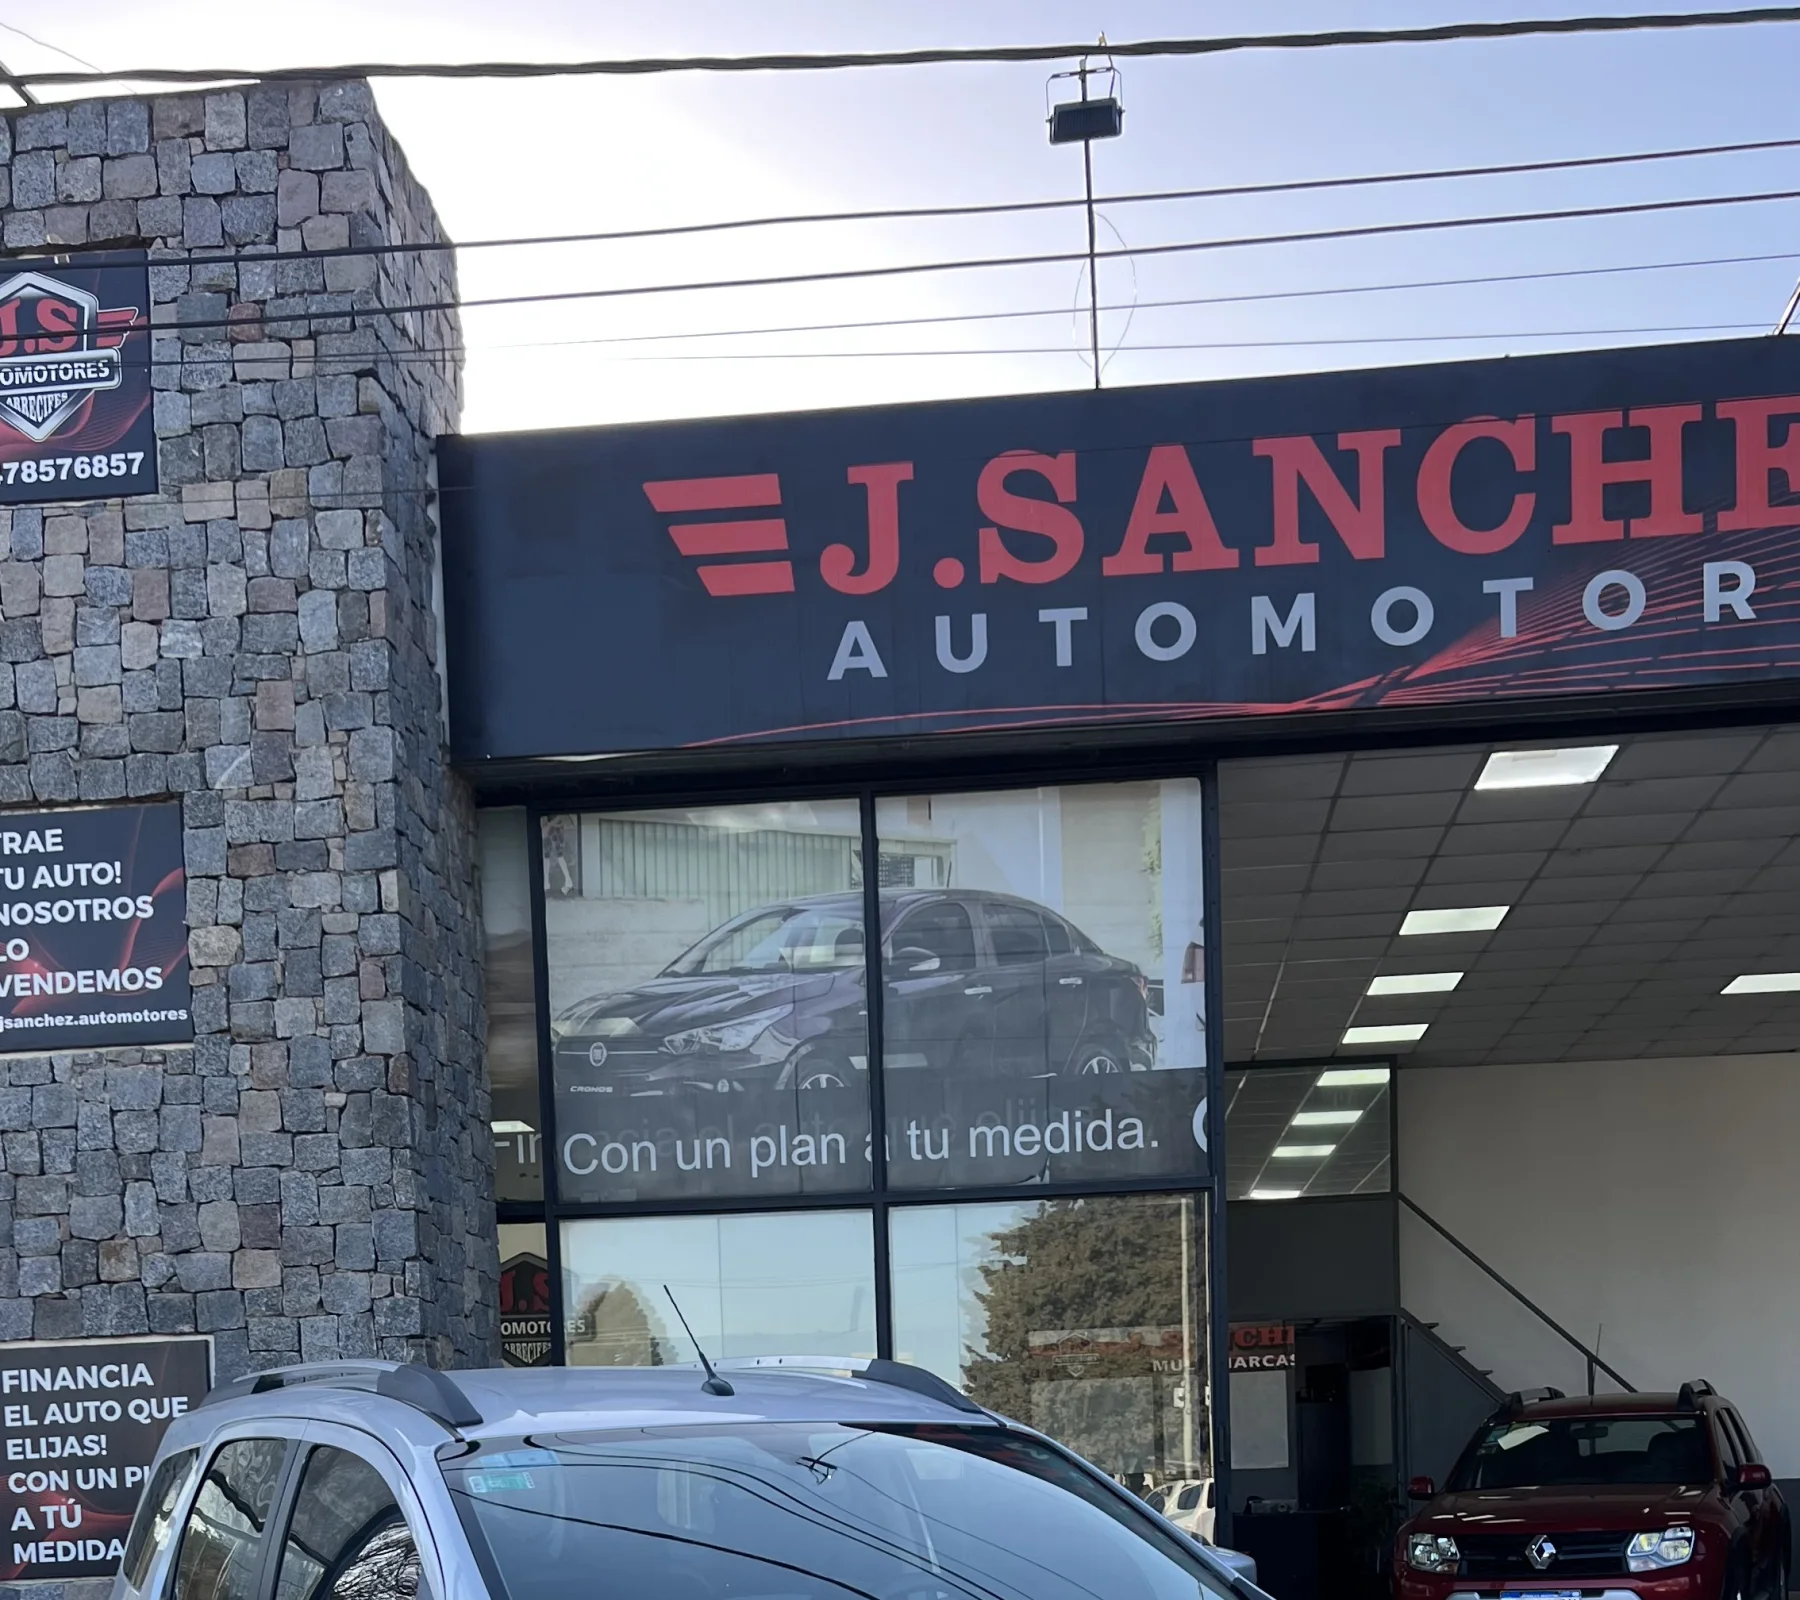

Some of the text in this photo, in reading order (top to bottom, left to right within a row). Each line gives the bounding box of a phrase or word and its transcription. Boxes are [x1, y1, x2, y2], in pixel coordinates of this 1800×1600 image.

[6, 392, 68, 422] ARRECIFES
[0, 452, 144, 484] 78576857
[820, 395, 1800, 594] J.SANCHE
[827, 560, 1757, 681] AUTOMOTOR
[0, 829, 64, 854] RAE
[32, 861, 122, 889] AUTO!
[563, 1133, 657, 1175] Con
[676, 1137, 731, 1169] un
[750, 1125, 846, 1178] plan
[907, 1120, 949, 1160] tu
[969, 1109, 1159, 1158] medida.
[2, 1363, 154, 1394] FINANCIA
[4, 1397, 189, 1427] EL AUTO QUE
[6, 1434, 107, 1460] ELIJAS!
[8, 1469, 69, 1493] CON
[76, 1467, 117, 1490] UN
[10, 1498, 82, 1531] A TÚ
[13, 1538, 125, 1564] MEDIDA
